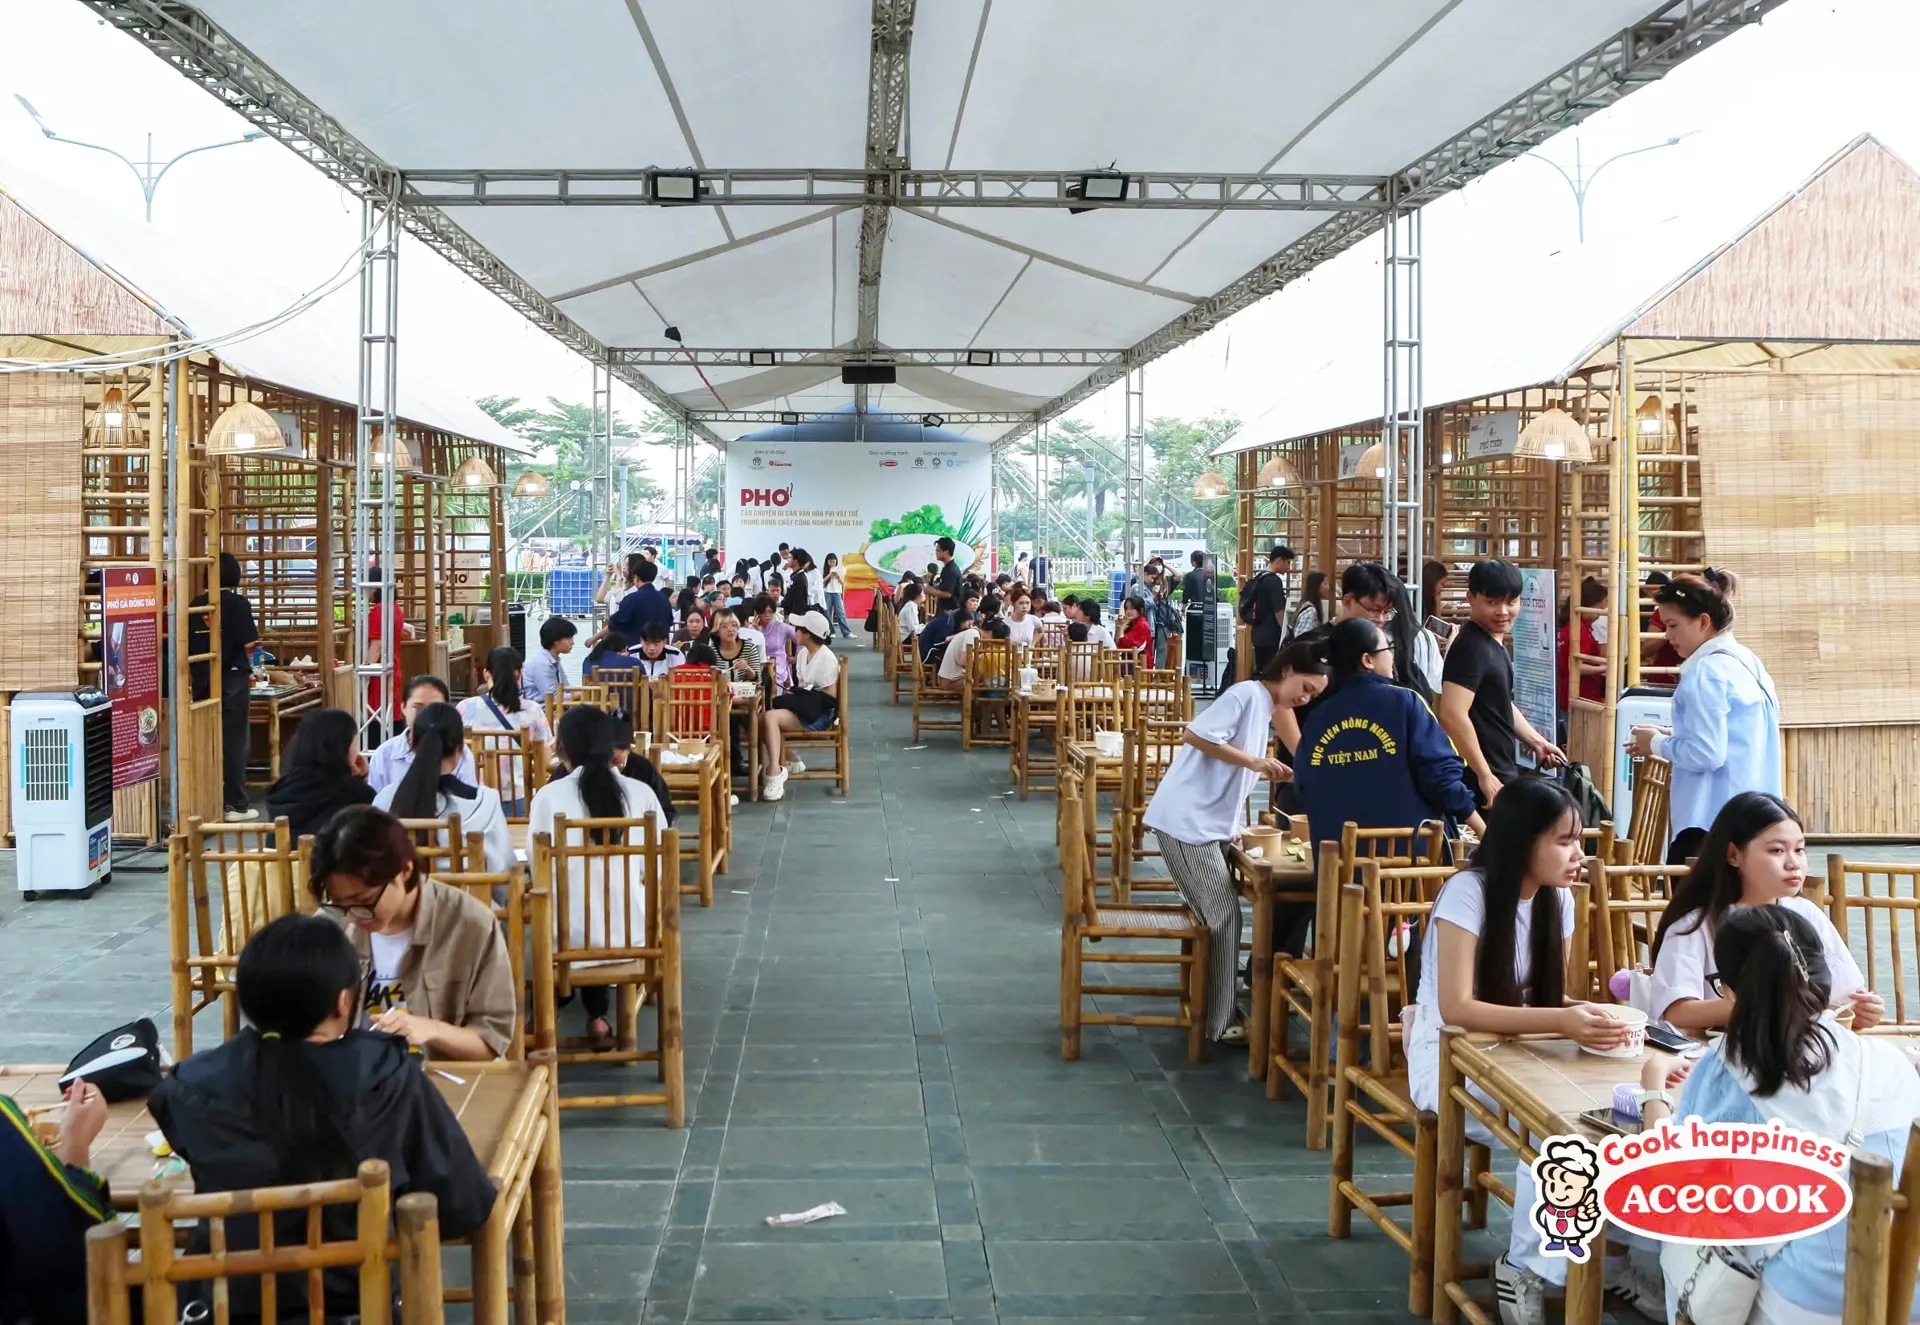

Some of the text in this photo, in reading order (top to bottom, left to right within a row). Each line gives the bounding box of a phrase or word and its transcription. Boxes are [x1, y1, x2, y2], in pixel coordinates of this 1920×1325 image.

[1311, 716, 1397, 766] HỌC VIỆN NÔNG NGHIỆP
[1328, 748, 1378, 766] VIỆT NAM
